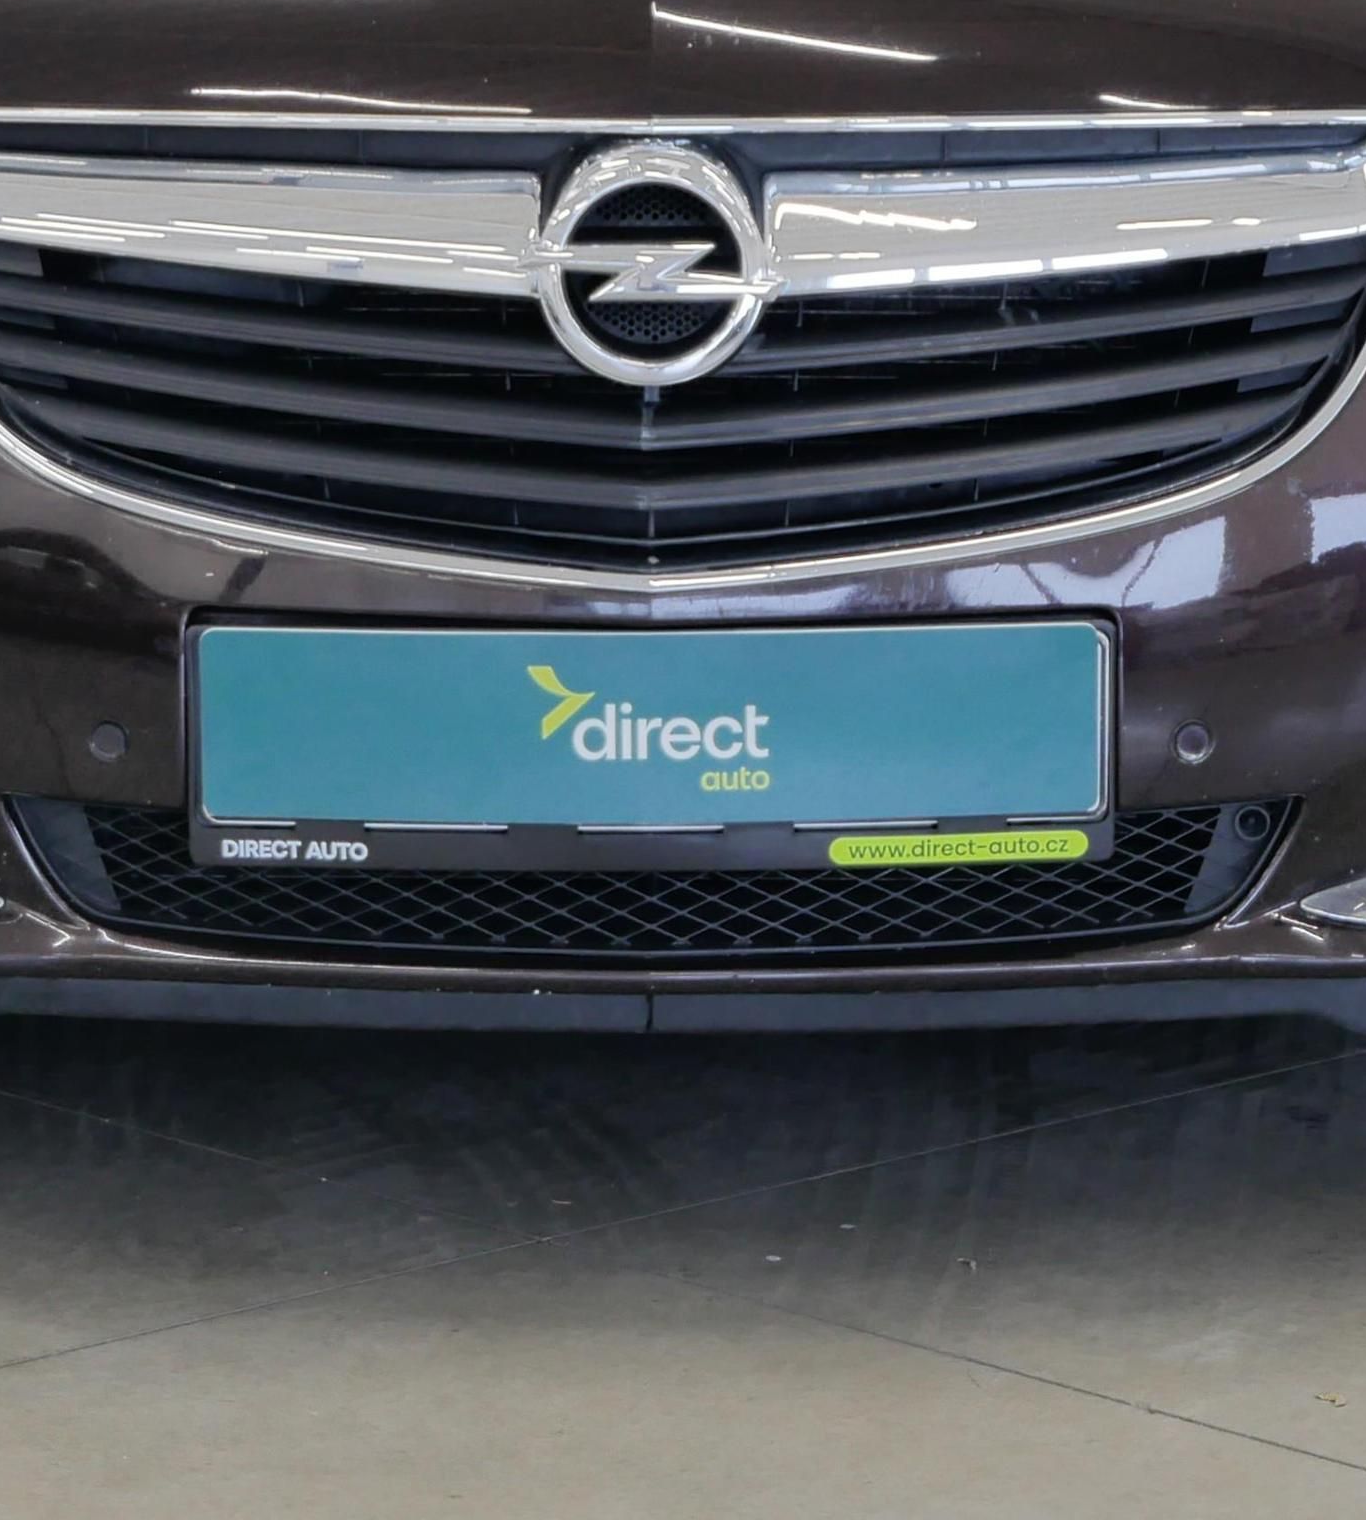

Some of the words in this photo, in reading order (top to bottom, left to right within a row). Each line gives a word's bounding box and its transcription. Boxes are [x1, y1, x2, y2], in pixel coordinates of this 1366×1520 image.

[572, 702, 770, 760] direct
[700, 766, 770, 791] auto
[221, 839, 302, 859] DIRECT
[305, 841, 368, 861] AUTO
[848, 837, 1069, 859] www.direct-auto.cz
